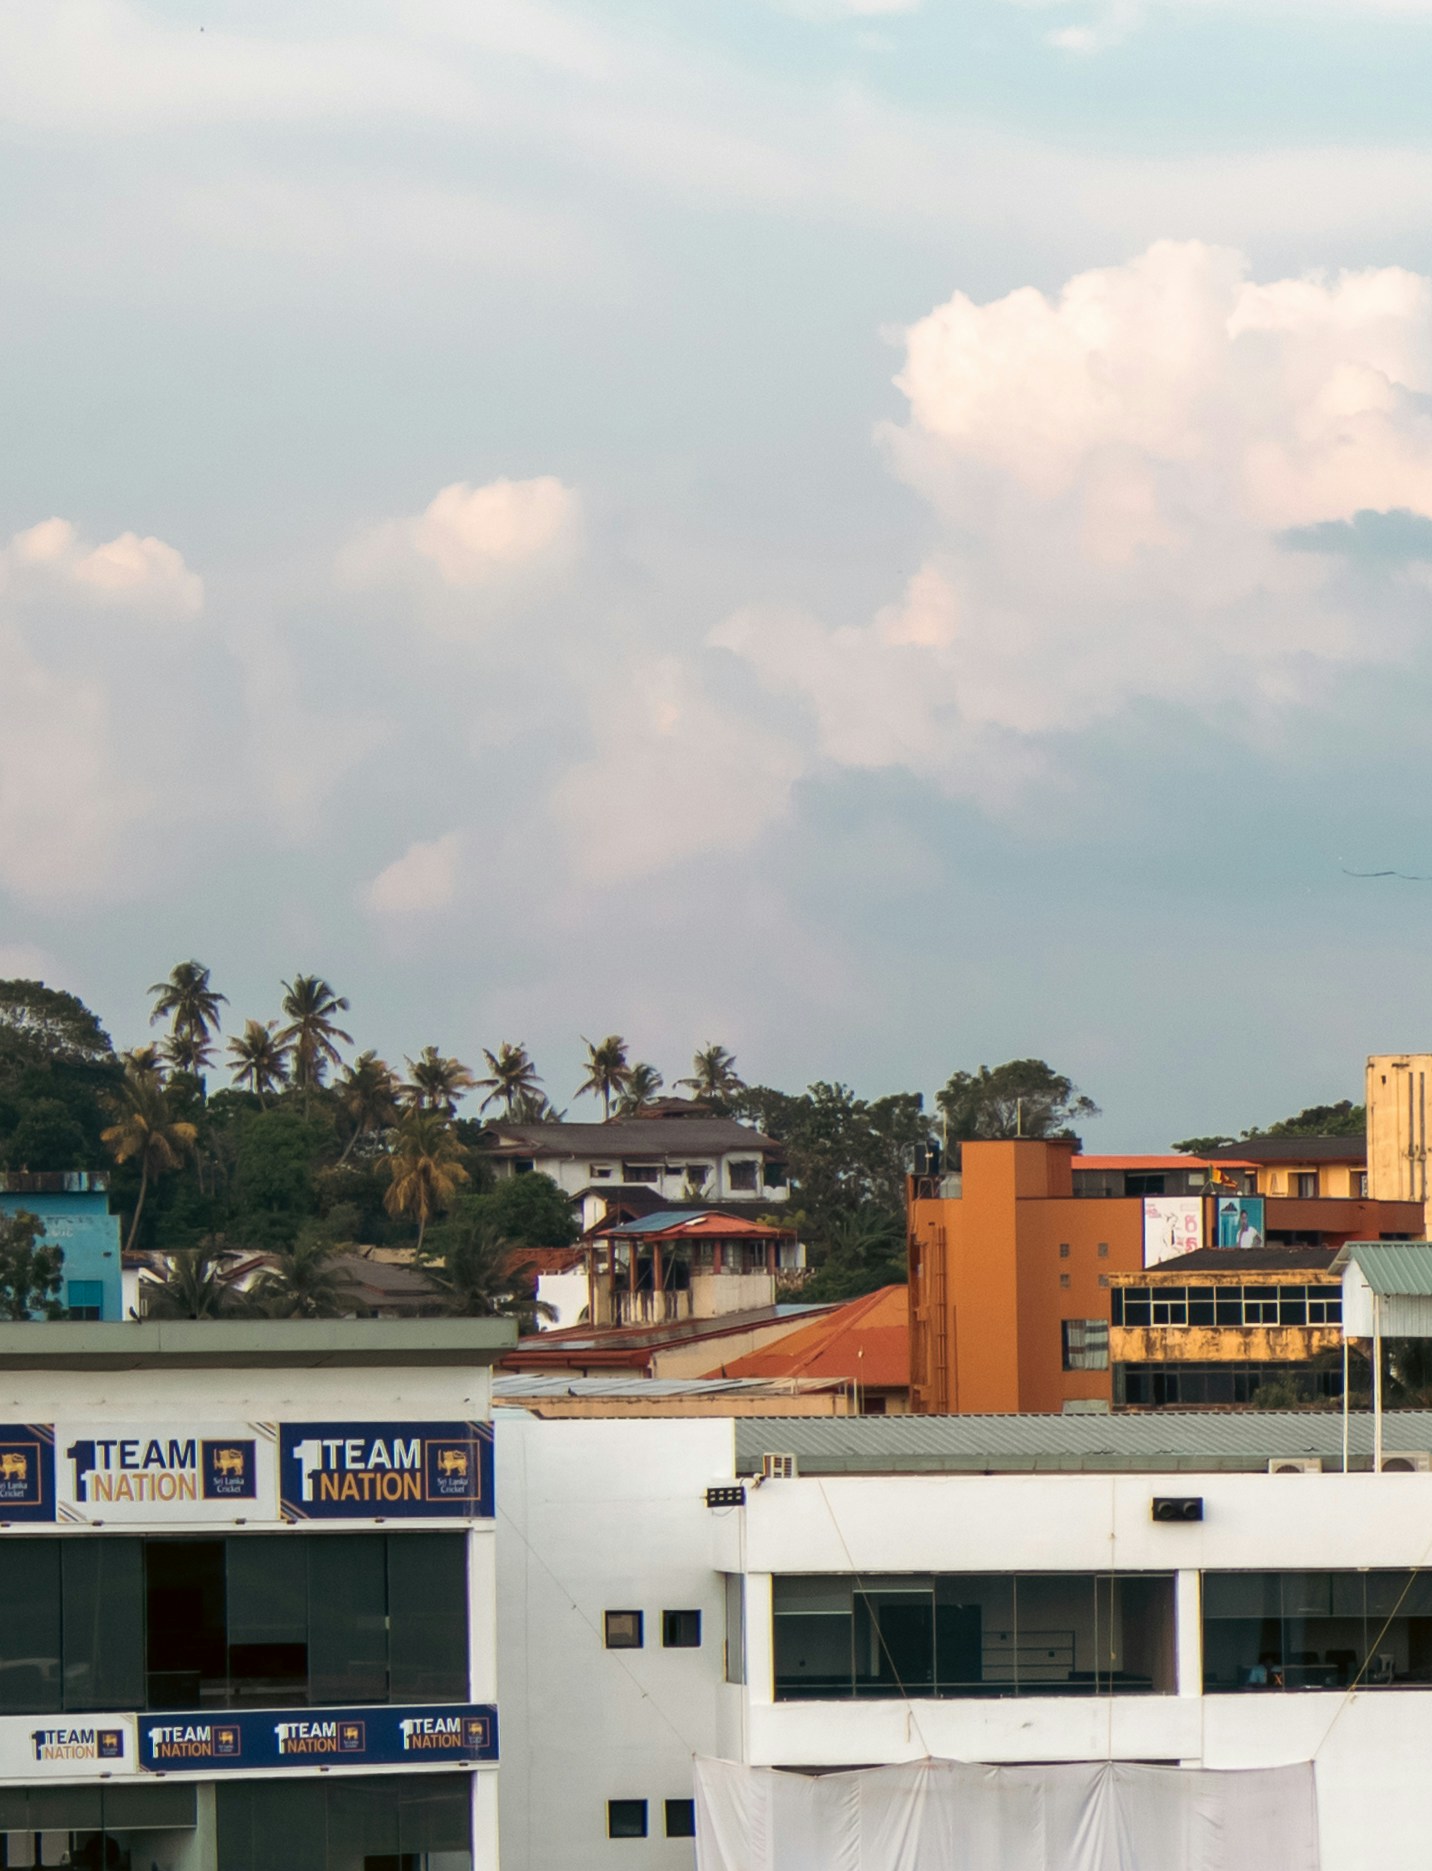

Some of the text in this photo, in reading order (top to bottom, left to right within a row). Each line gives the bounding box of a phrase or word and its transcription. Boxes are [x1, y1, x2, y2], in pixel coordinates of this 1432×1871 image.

[97, 1439, 196, 1469] TEAM
[323, 1439, 420, 1469] TEAM
[94, 1472, 197, 1501] NATION
[213, 1477, 244, 1485] Sri Lanka
[217, 1485, 241, 1493] Cricket
[321, 1472, 421, 1500] NATION
[440, 1485, 465, 1493] Cricket
[162, 1742, 211, 1758] NATION
[288, 1738, 337, 1754] NATION
[413, 1734, 461, 1750] NATION
[46, 1744, 95, 1759] NATION
